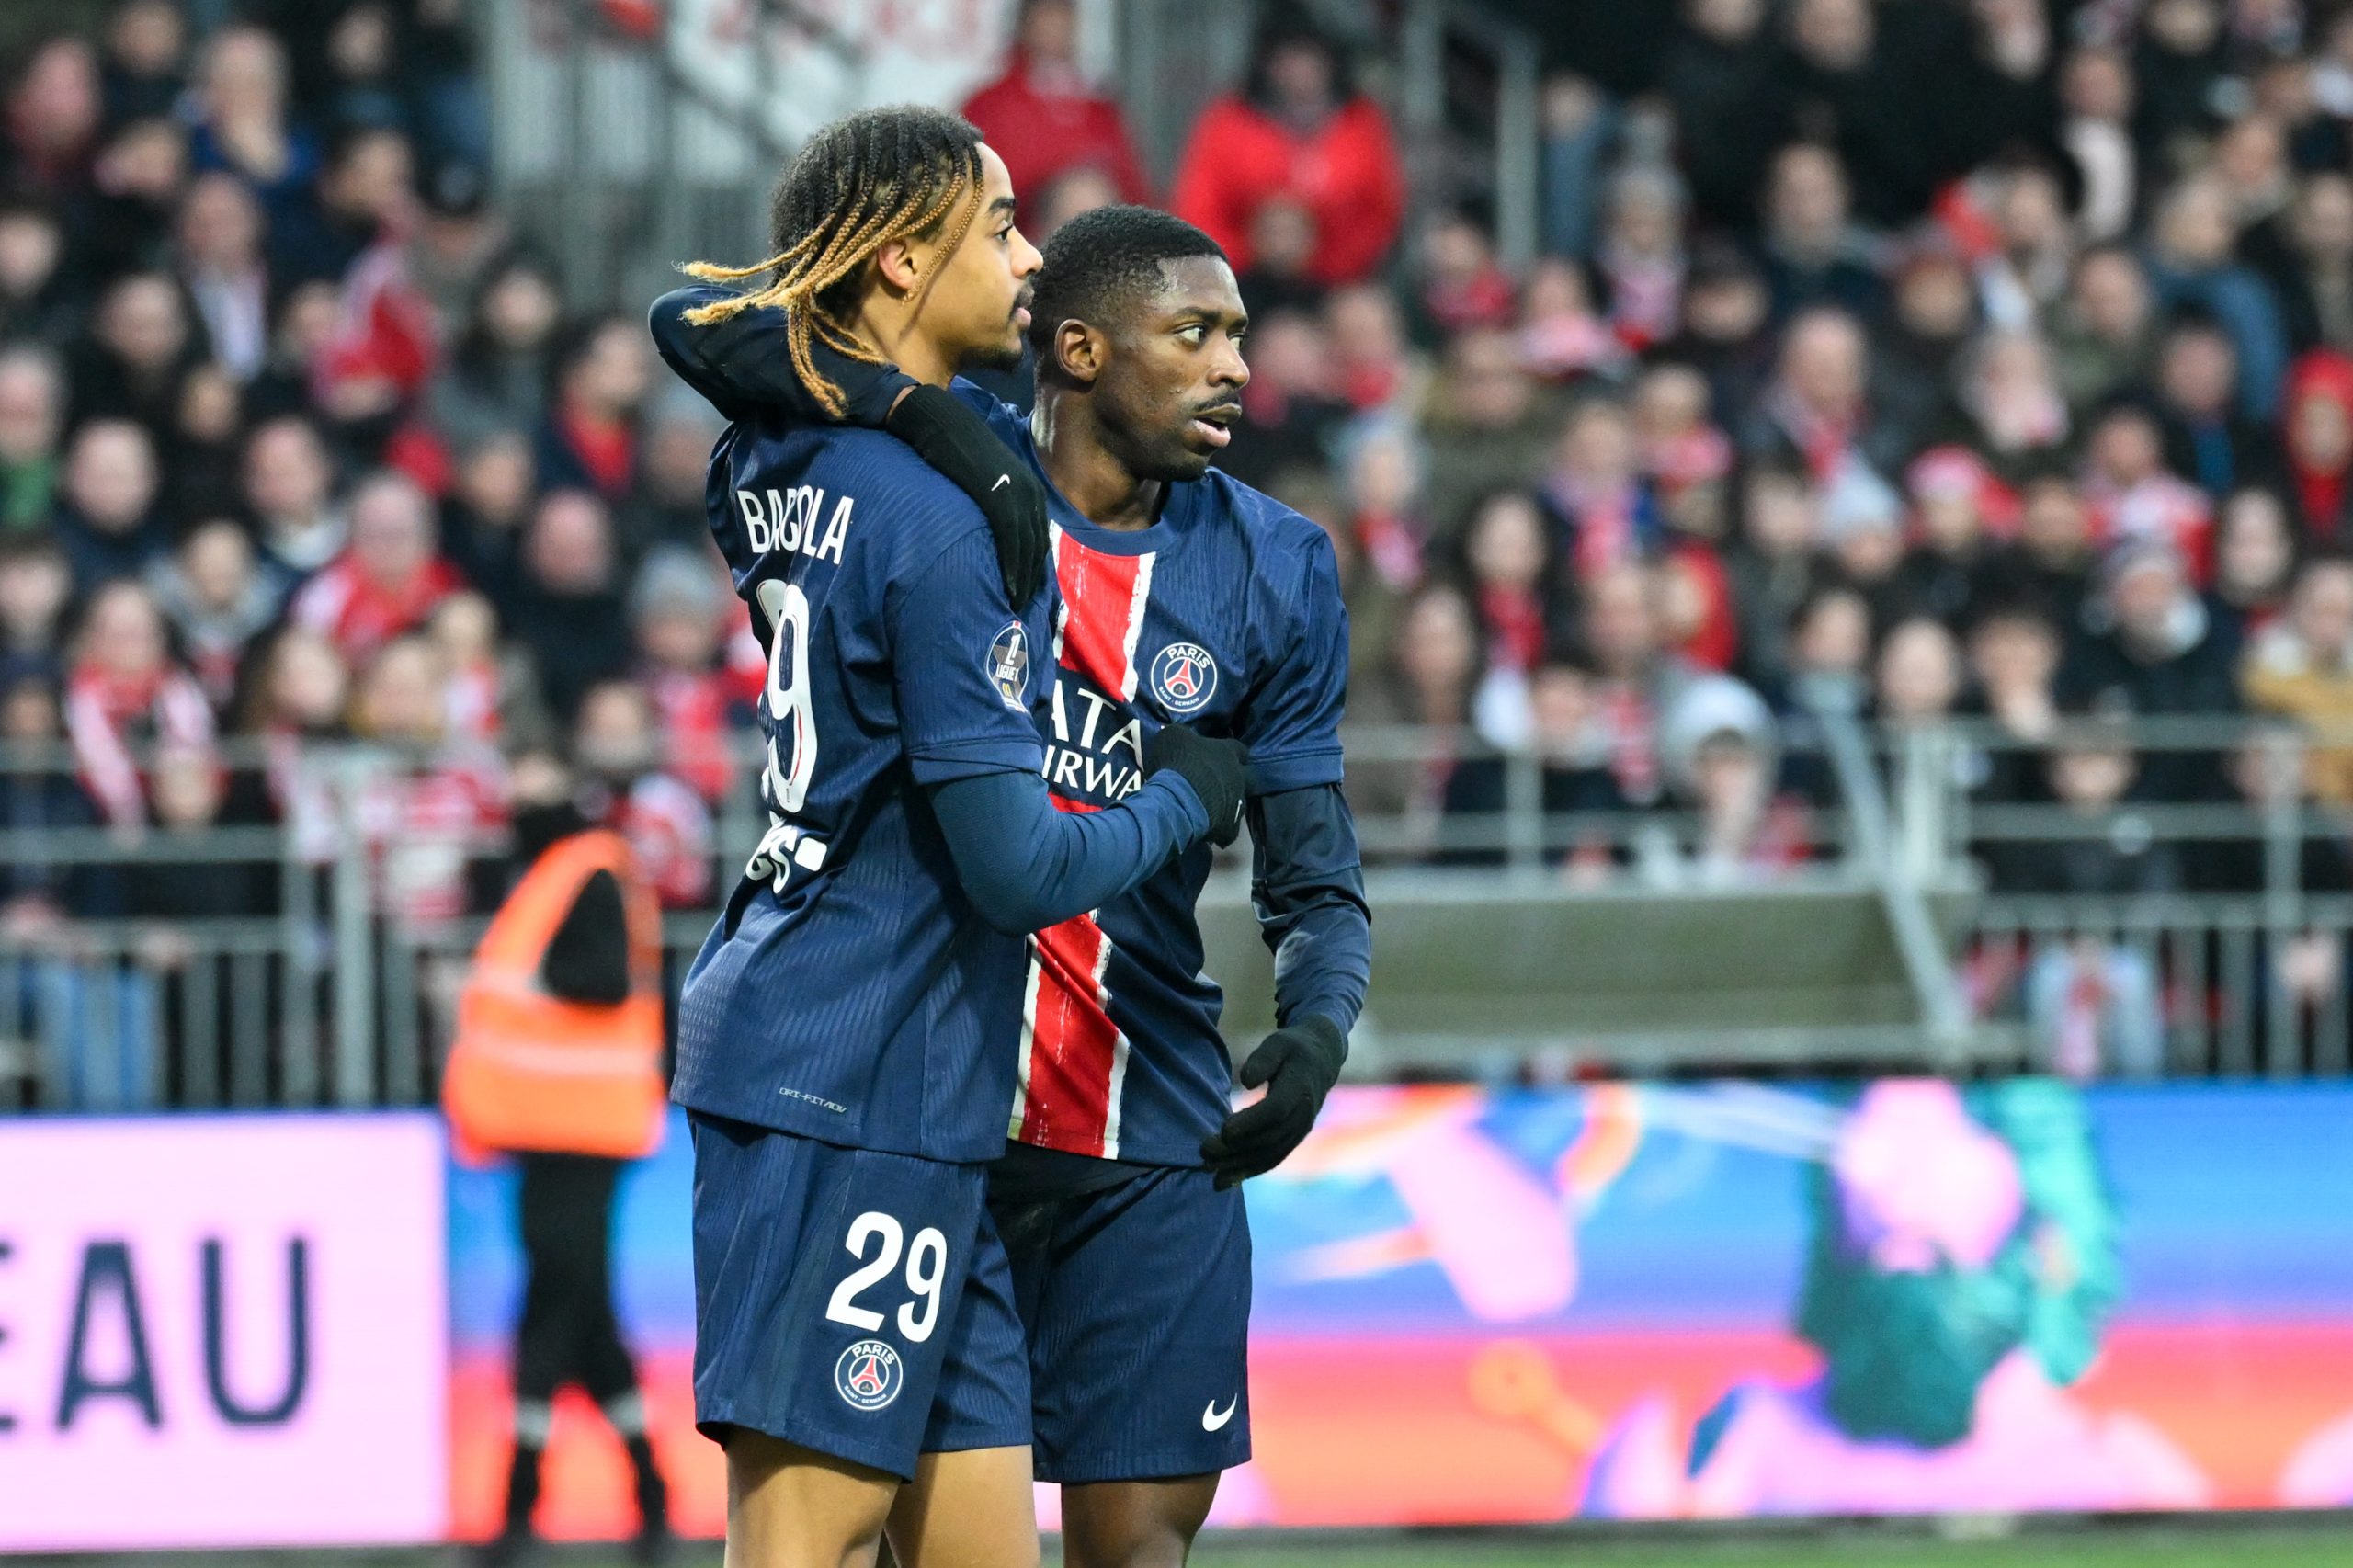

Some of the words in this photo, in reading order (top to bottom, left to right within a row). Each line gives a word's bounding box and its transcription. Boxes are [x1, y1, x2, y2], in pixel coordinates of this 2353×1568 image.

[1166, 645, 1211, 669] PARIS
[825, 1211, 948, 1343] 29
[0, 1238, 311, 1428] AU
[851, 1344, 895, 1365] PARIS
